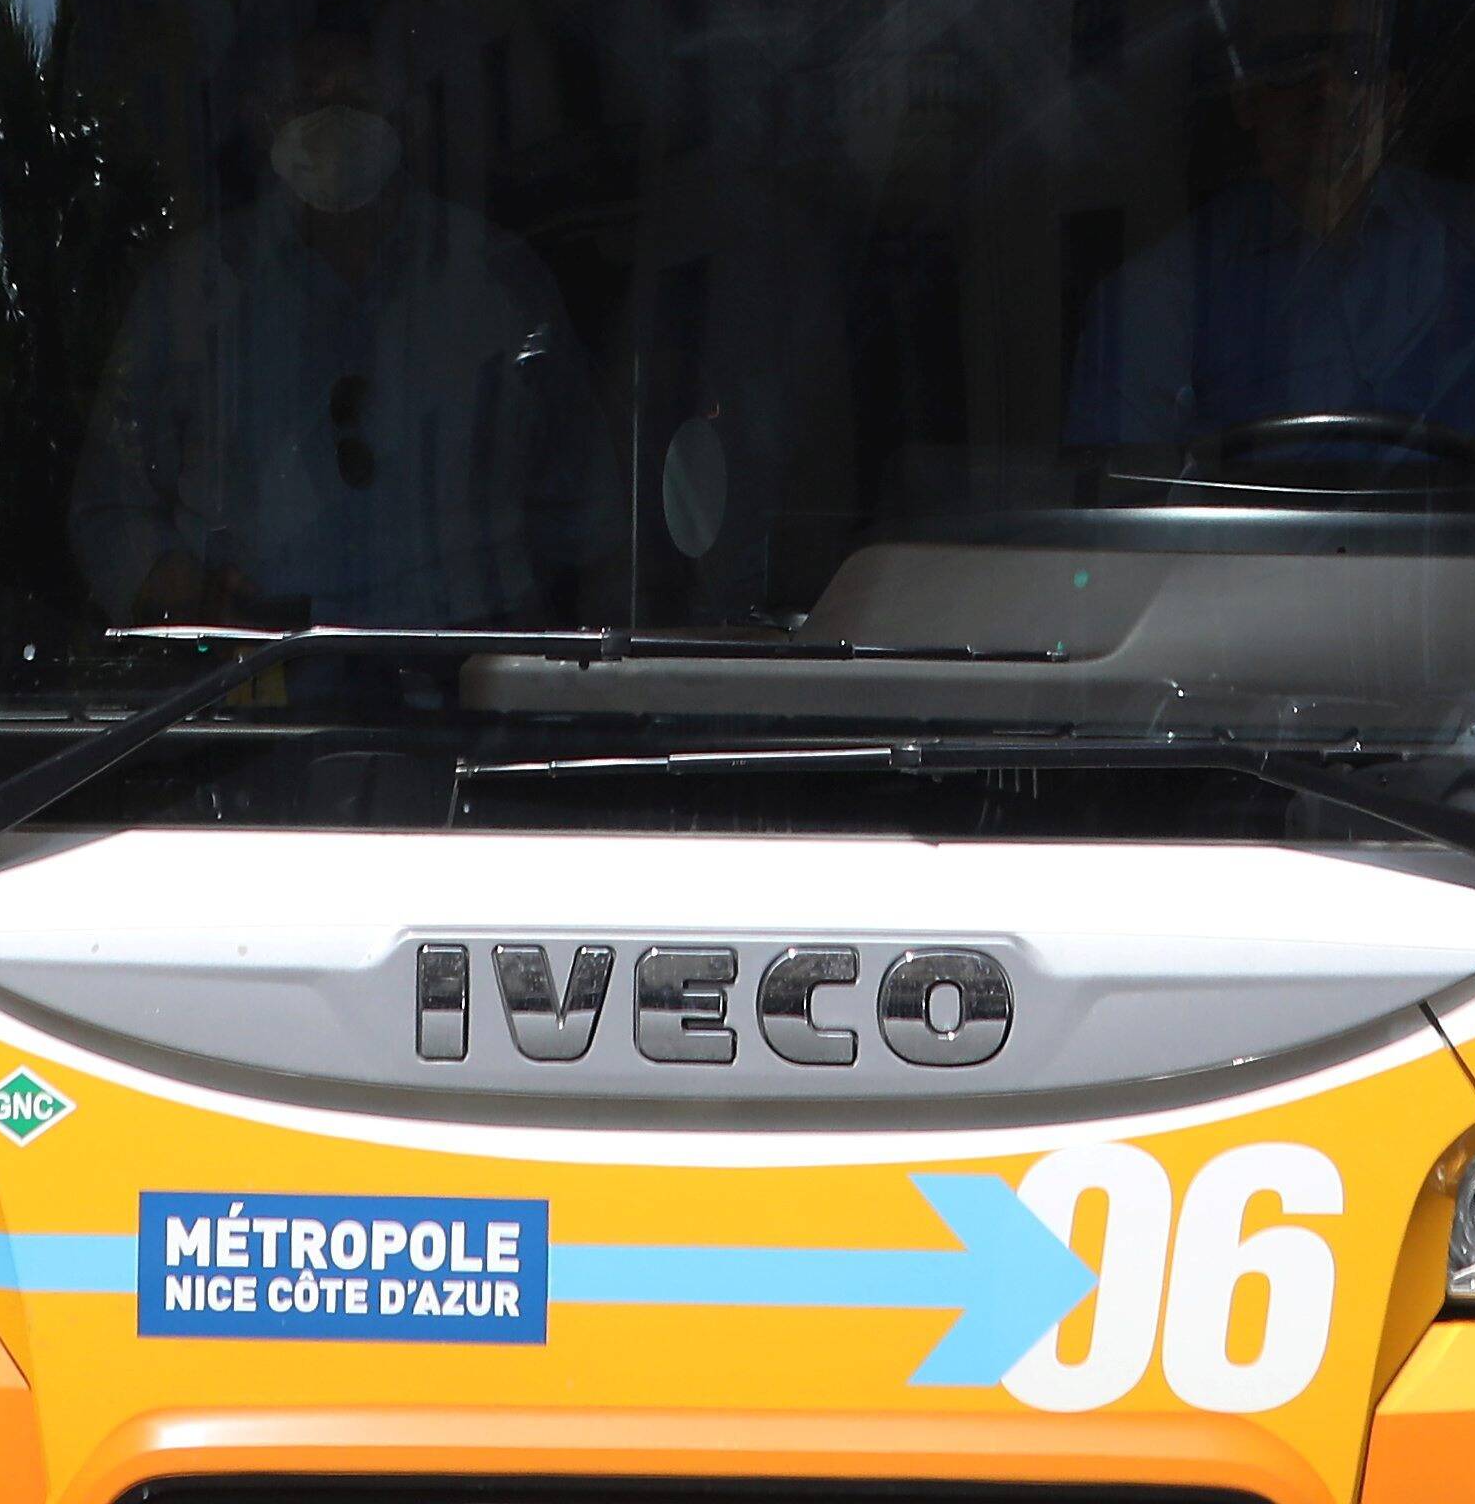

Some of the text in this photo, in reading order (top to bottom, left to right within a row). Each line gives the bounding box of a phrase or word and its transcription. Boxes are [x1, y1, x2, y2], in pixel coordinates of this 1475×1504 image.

[416, 944, 1014, 1067] IVECO
[166, 1201, 521, 1273] MÉTROPOLE
[999, 1141, 1344, 1413] 06
[164, 1267, 521, 1318] NICE CÔTE D'AZUR
